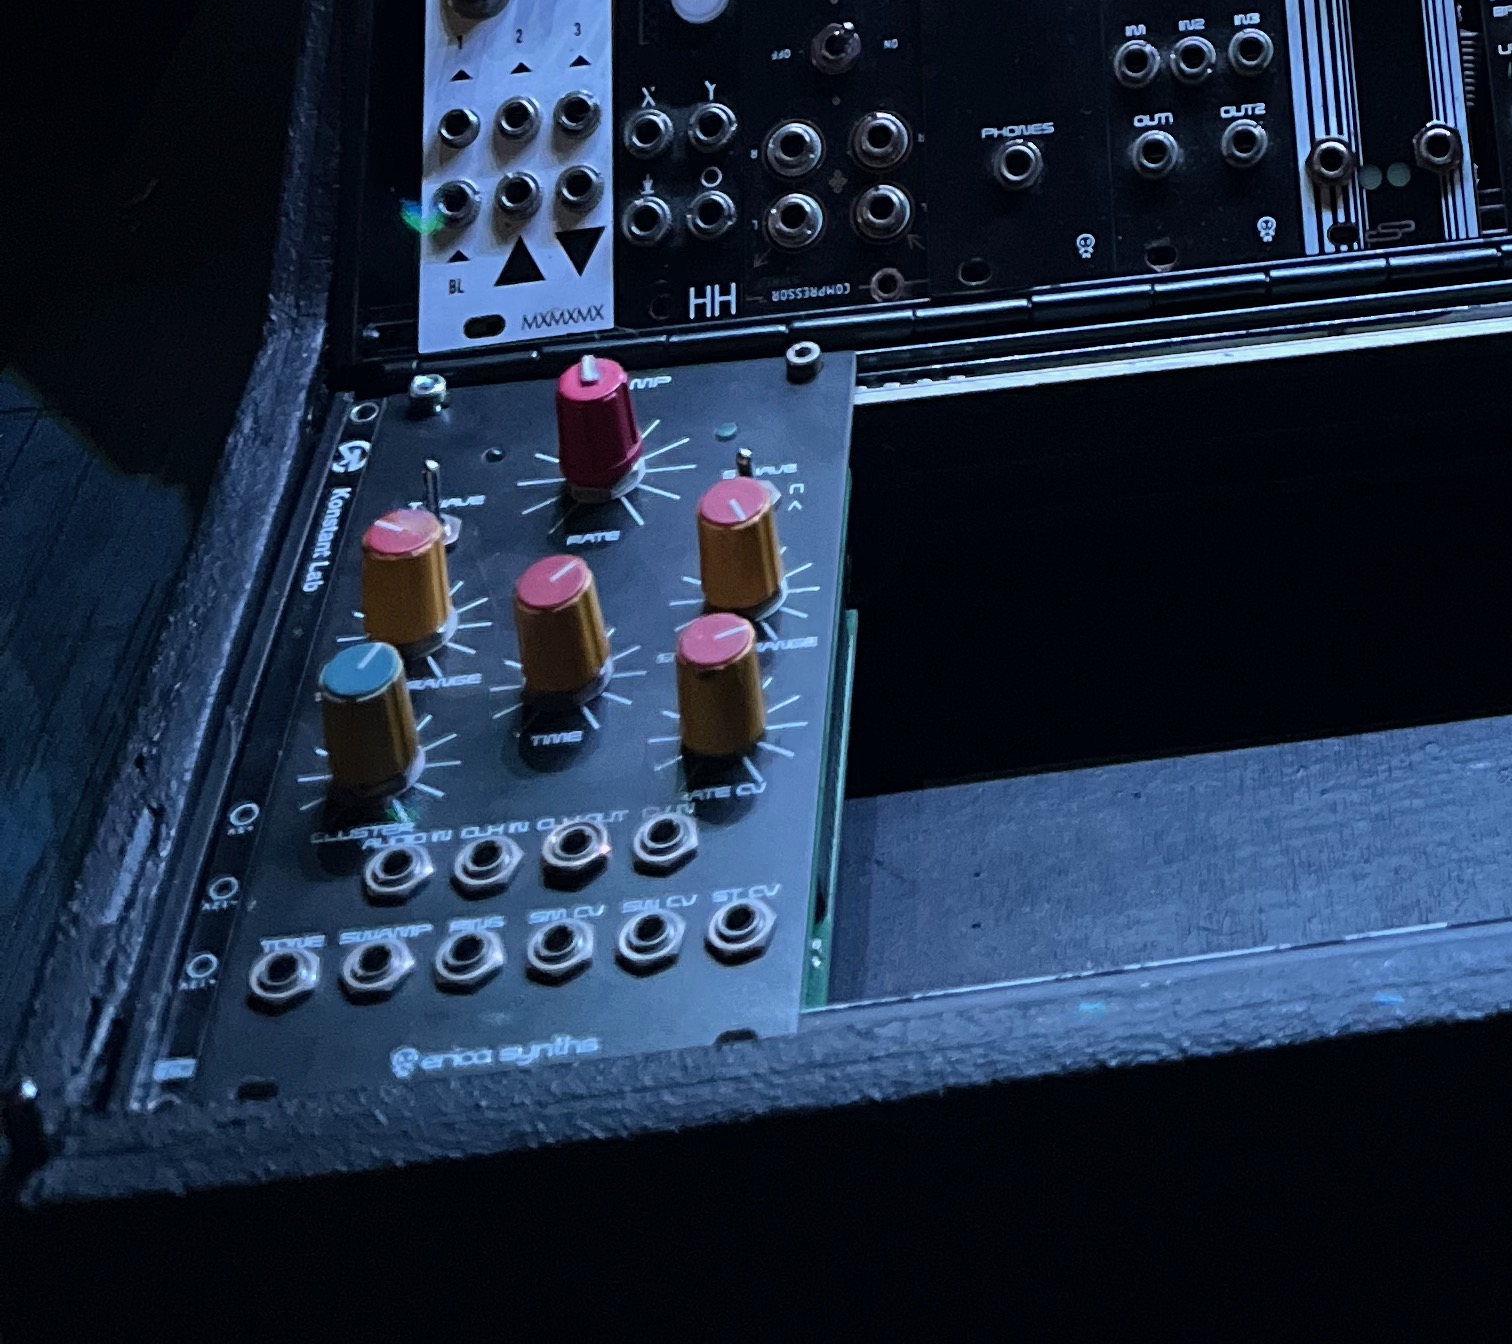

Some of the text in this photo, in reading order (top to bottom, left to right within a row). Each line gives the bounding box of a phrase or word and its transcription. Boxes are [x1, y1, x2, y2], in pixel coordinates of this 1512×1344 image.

[981, 122, 1054, 139] PHONES
[689, 283, 737, 319] HH
[771, 283, 851, 301] COMPRESSOR
[302, 488, 354, 592] Konstant Lab
[422, 1035, 599, 1072] erica synths
